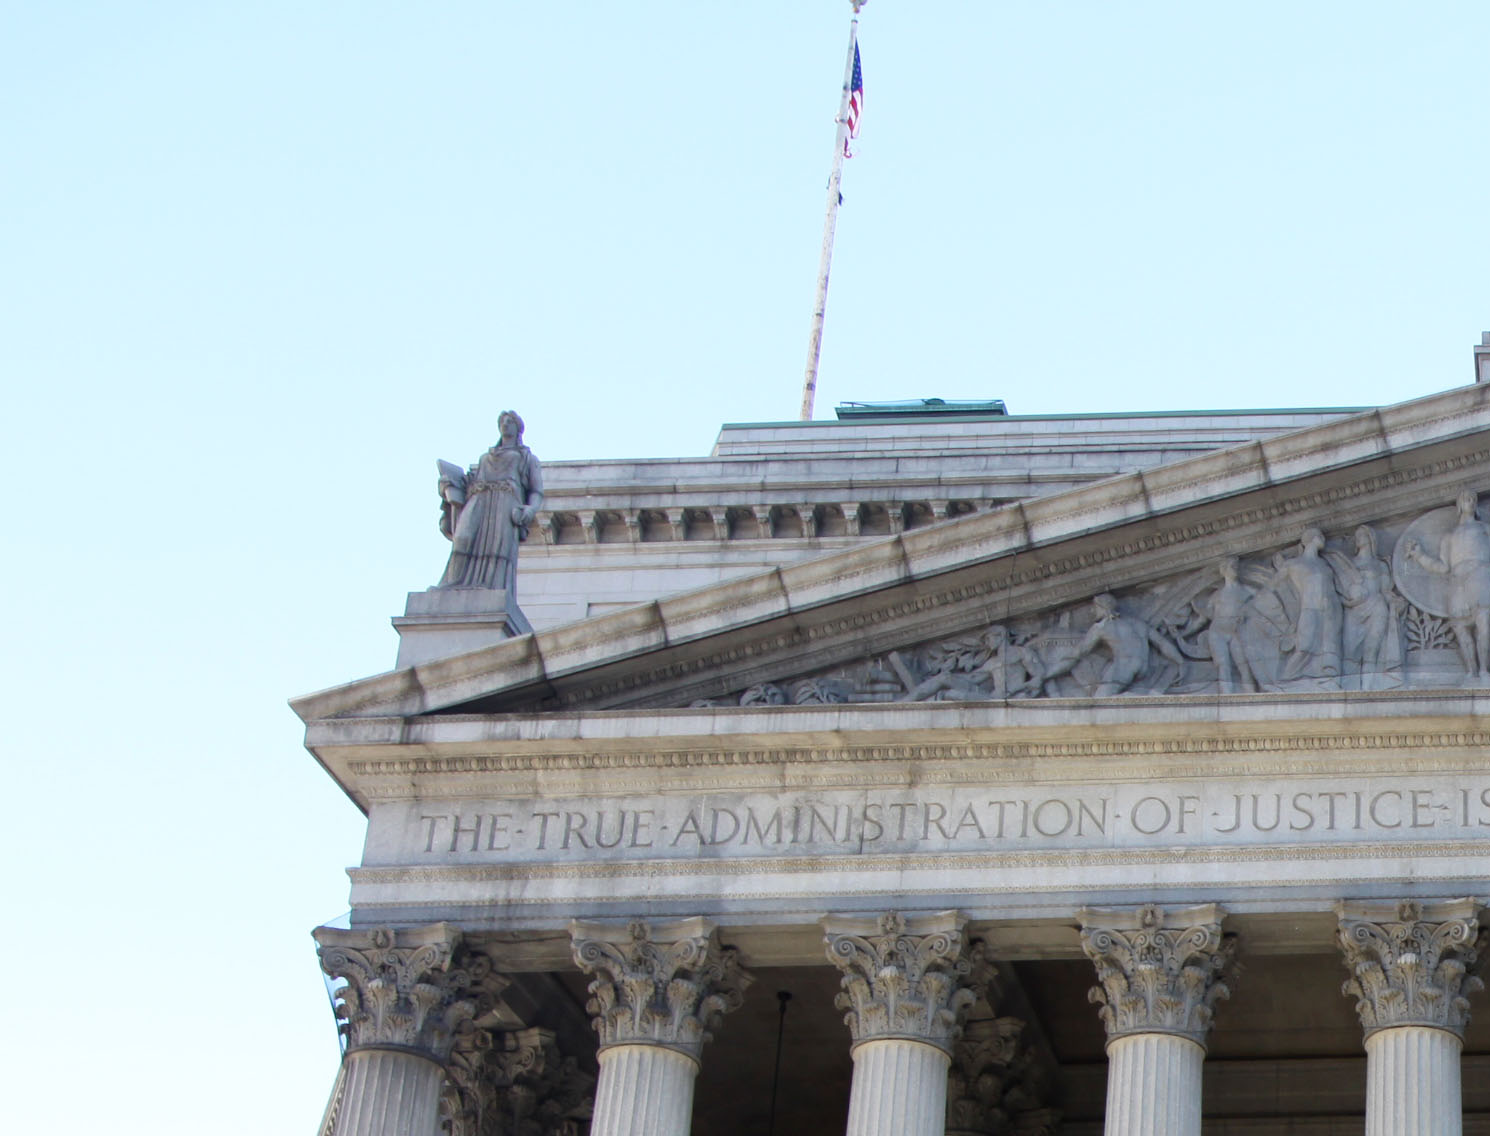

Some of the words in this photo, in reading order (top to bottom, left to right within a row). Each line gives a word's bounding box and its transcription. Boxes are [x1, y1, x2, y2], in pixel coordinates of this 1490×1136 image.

[421, 814, 512, 852] THE
[532, 809, 656, 850] TRUE
[670, 797, 1110, 848] ADMINISTRATION
[1130, 796, 1200, 834] OF
[1214, 790, 1435, 833] JUSTICE
